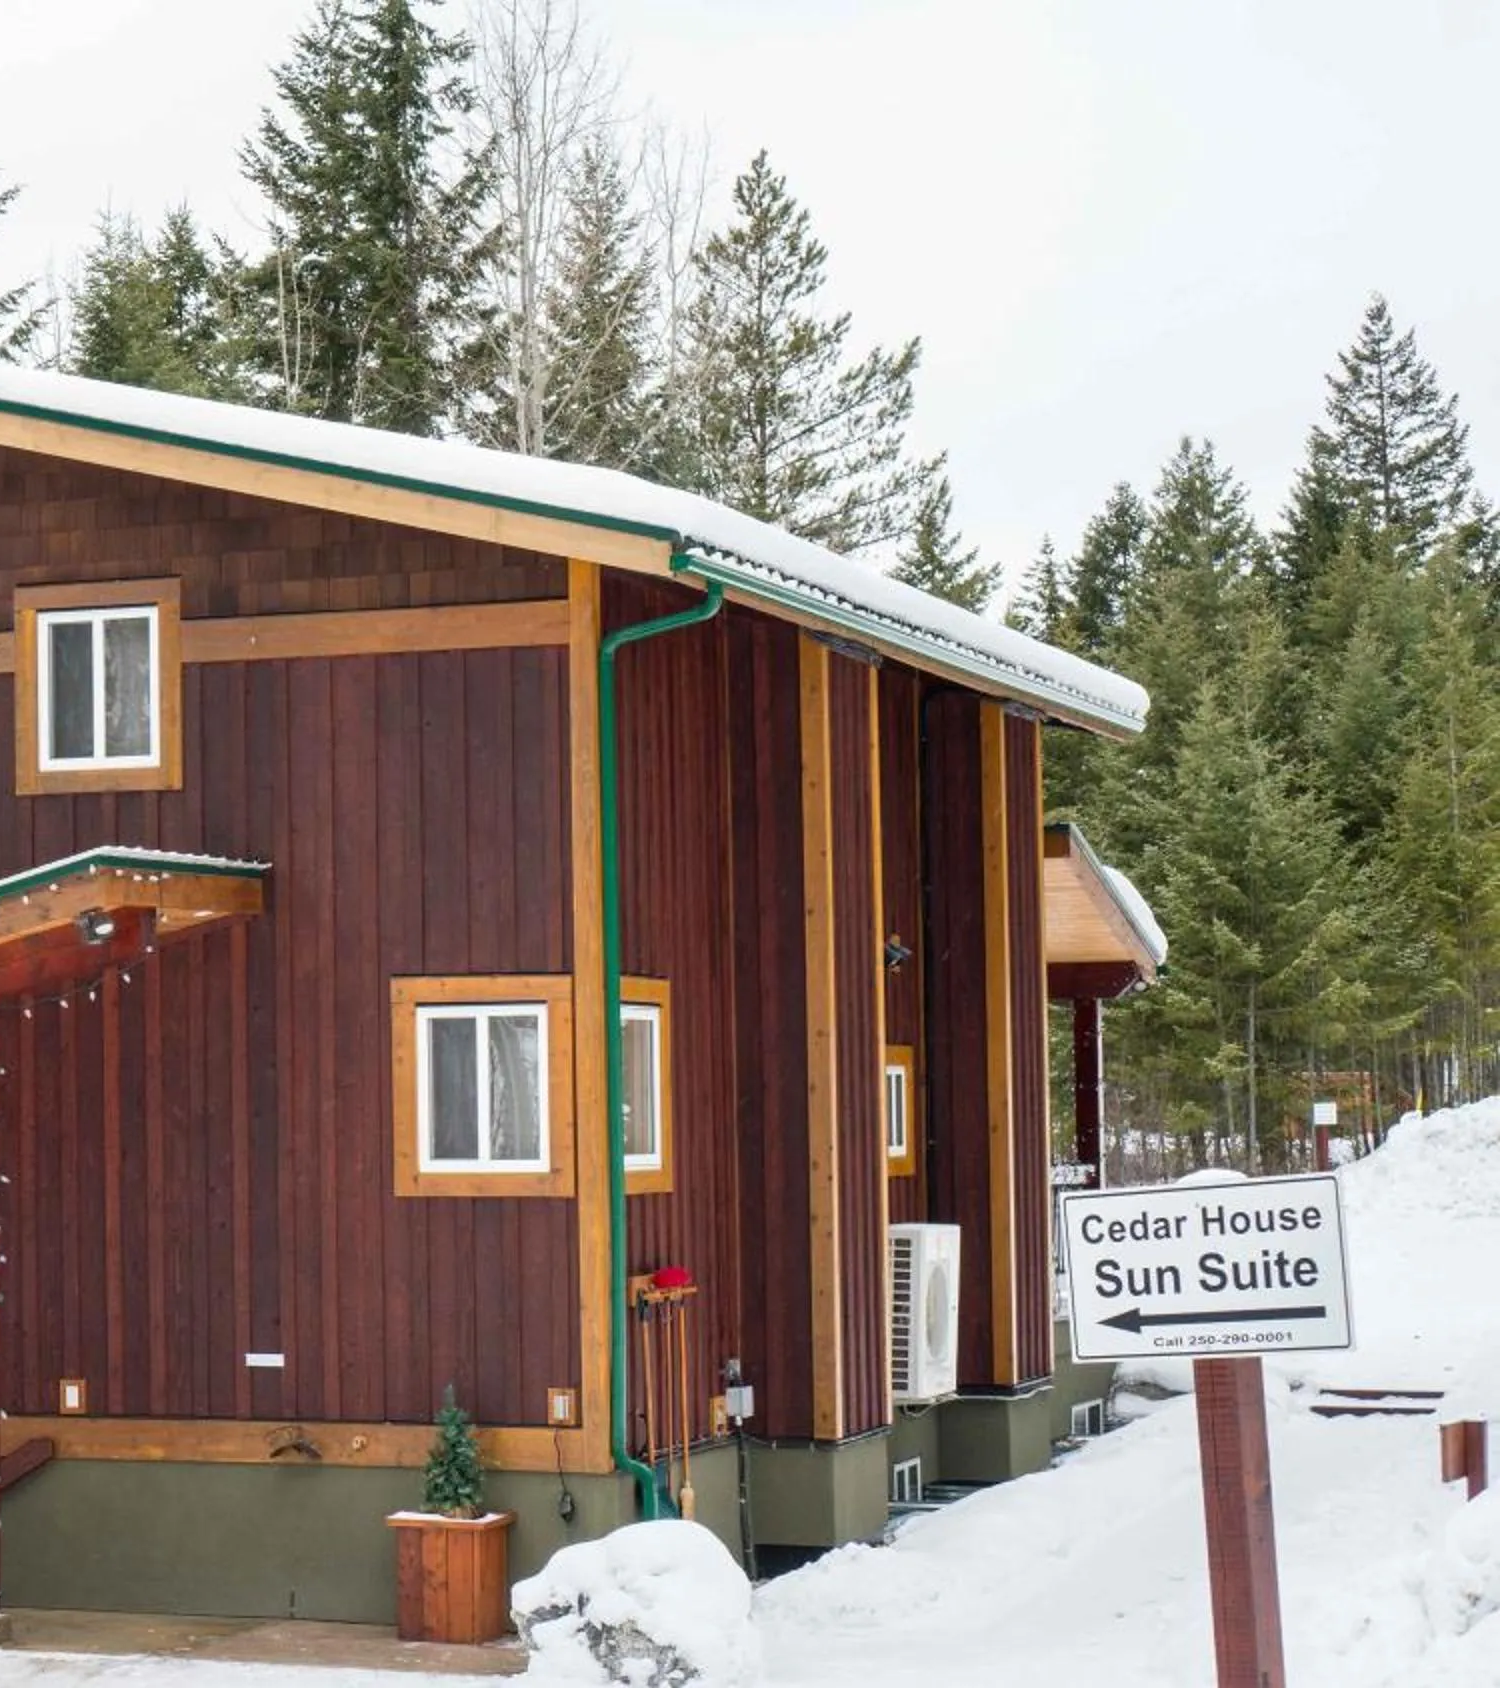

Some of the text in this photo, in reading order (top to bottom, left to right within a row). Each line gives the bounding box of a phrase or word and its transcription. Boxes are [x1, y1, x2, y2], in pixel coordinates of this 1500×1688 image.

[1081, 1205, 1323, 1244] Cedar House
[1095, 1249, 1319, 1299] Sun Suite
[1153, 1336, 1183, 1347] Call
